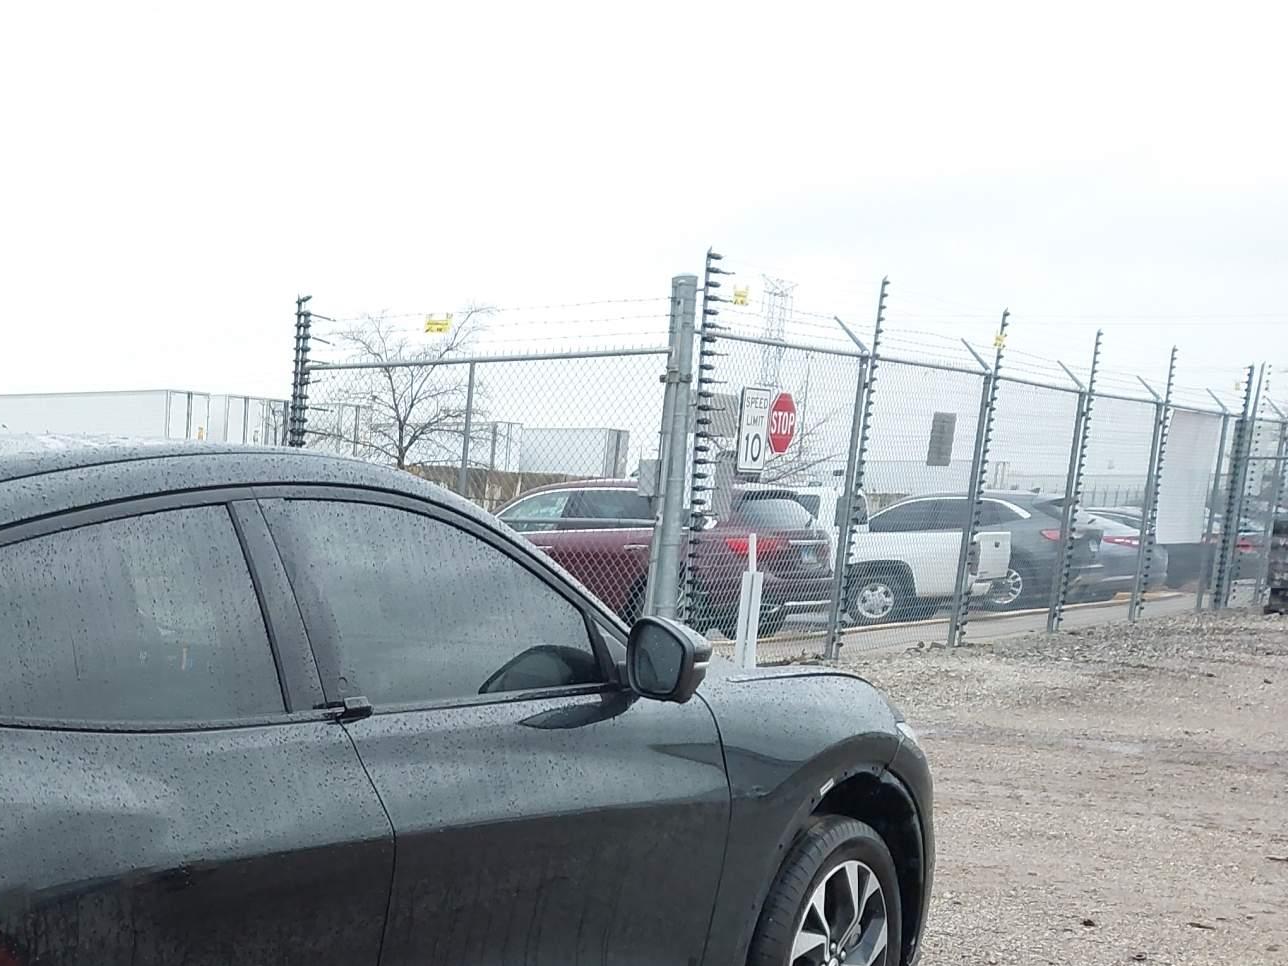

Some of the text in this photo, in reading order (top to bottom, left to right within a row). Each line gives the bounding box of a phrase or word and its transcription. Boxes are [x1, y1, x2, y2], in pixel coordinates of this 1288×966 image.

[745, 396, 769, 410] SPEED
[746, 415, 766, 428] LIMIT
[770, 410, 796, 436] STOP
[744, 432, 762, 463] 10
